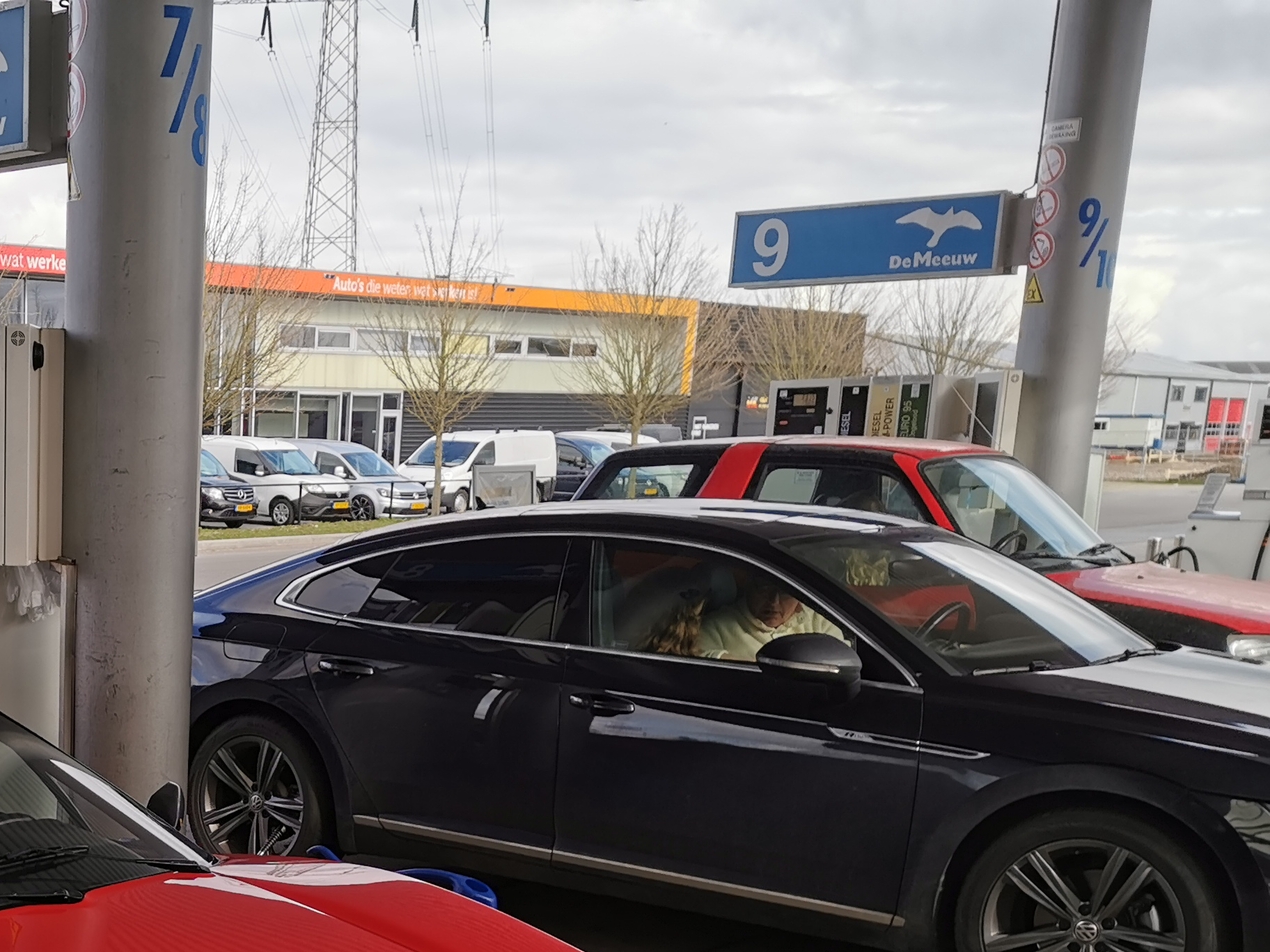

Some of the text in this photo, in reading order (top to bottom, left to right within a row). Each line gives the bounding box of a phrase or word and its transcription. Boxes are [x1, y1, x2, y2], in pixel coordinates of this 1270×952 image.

[752, 218, 789, 277] 9
[0, 253, 24, 269] wat
[27, 254, 66, 271] werke
[333, 276, 364, 292] Auto's
[366, 279, 380, 294] die
